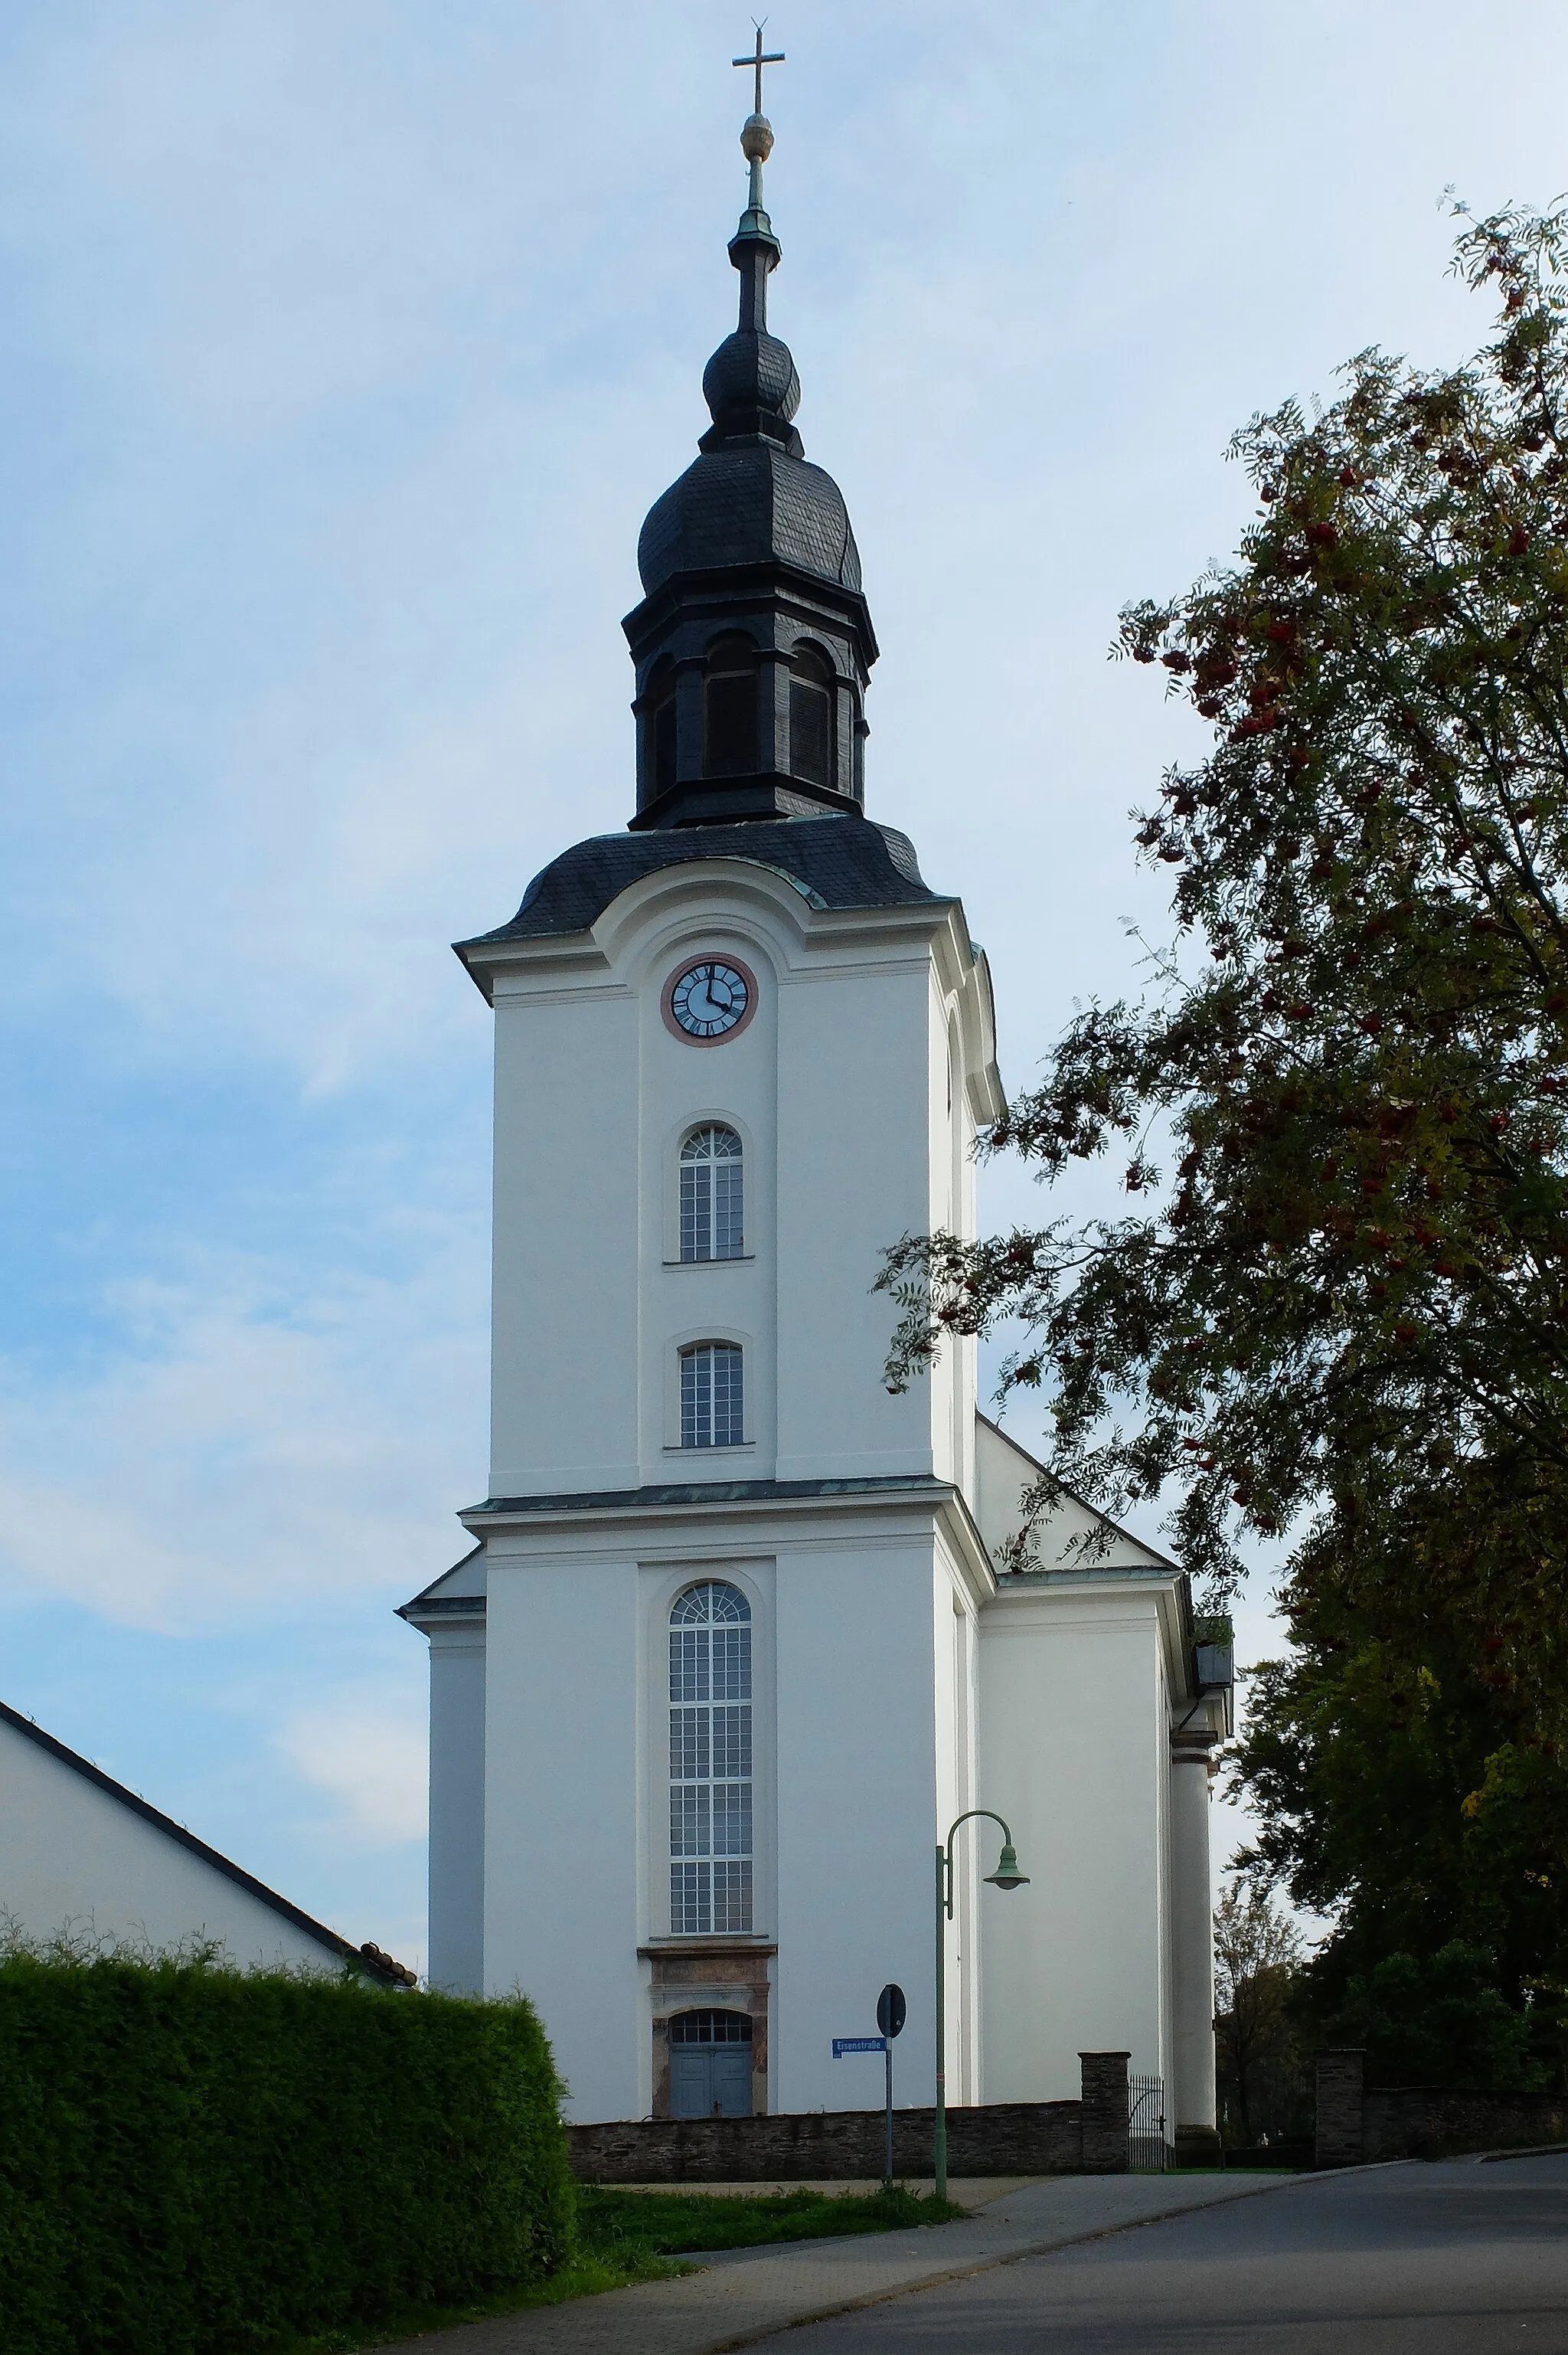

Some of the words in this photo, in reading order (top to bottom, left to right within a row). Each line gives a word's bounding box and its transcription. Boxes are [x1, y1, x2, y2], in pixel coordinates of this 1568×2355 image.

[730, 979, 743, 988] II
[733, 993, 746, 1002] III
[837, 2040, 880, 2049] Eisenstraße
